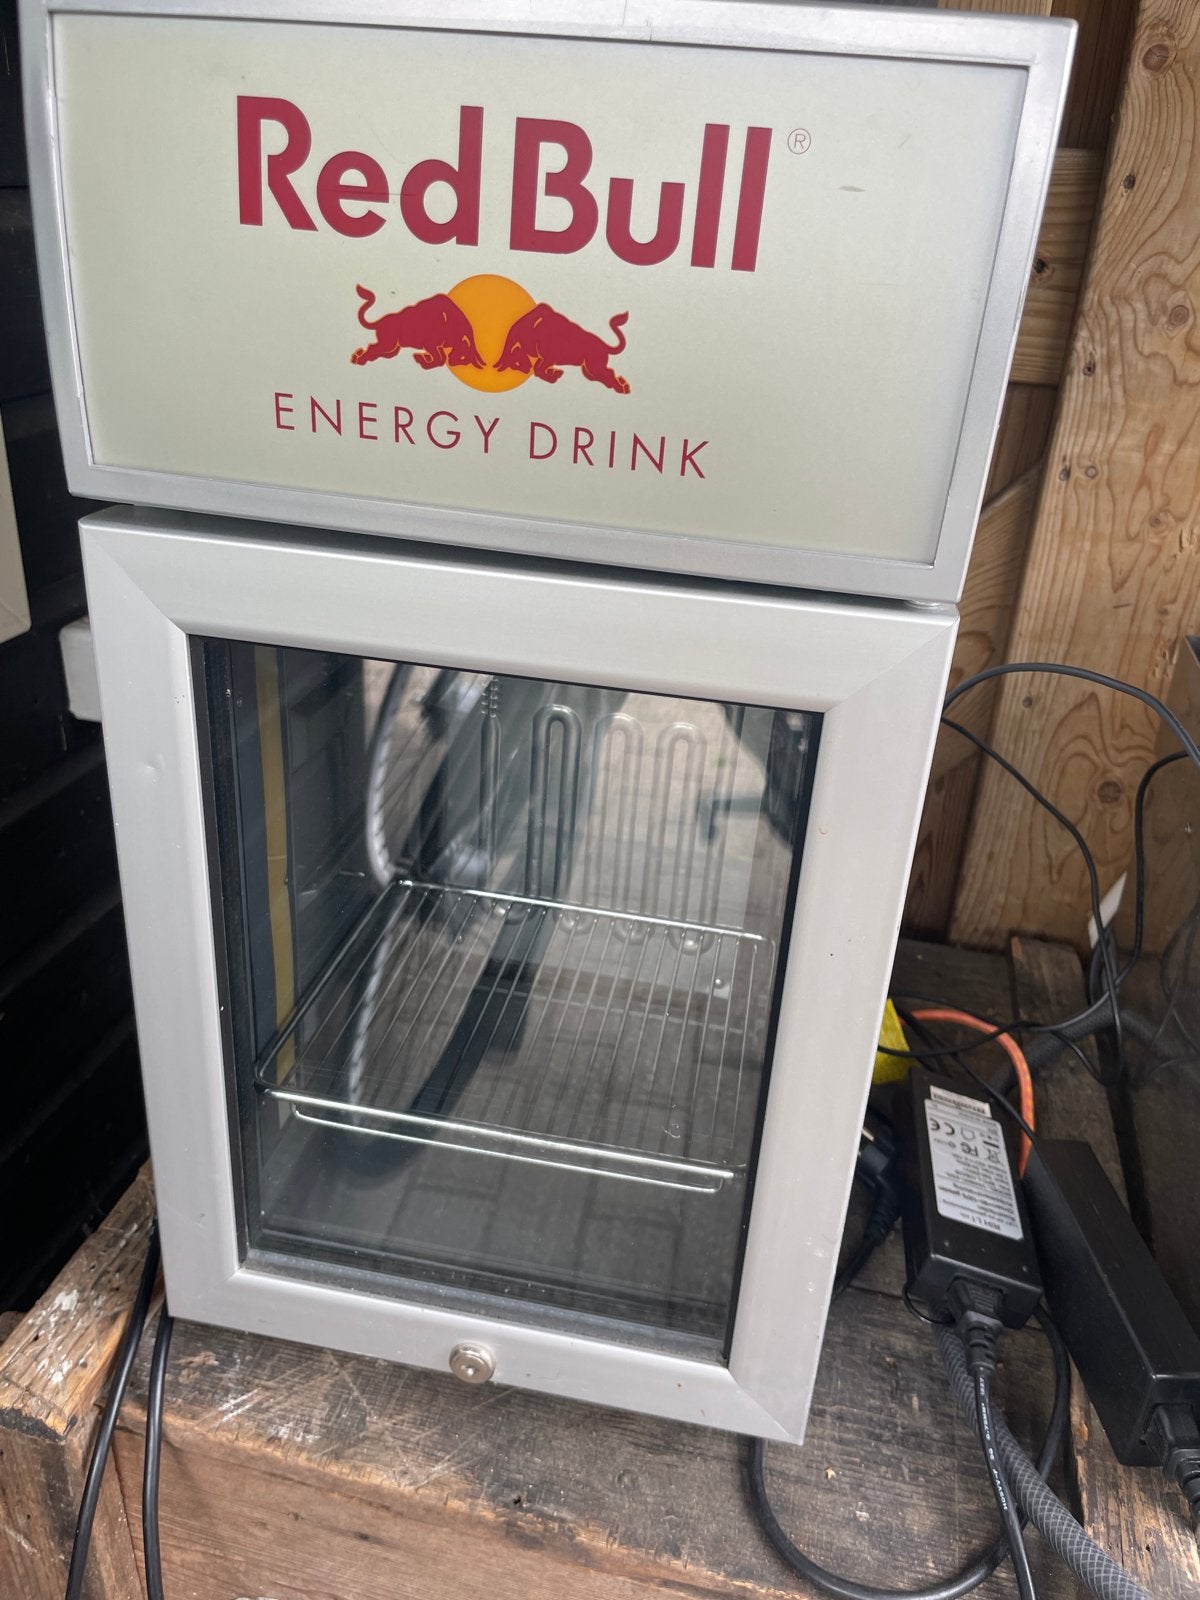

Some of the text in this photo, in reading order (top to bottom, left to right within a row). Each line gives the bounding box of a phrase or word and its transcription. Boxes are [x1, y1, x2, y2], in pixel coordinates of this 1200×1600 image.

[236, 95, 484, 246] Red
[509, 117, 773, 272] Bull
[274, 392, 709, 479] ENERGY DRINK
